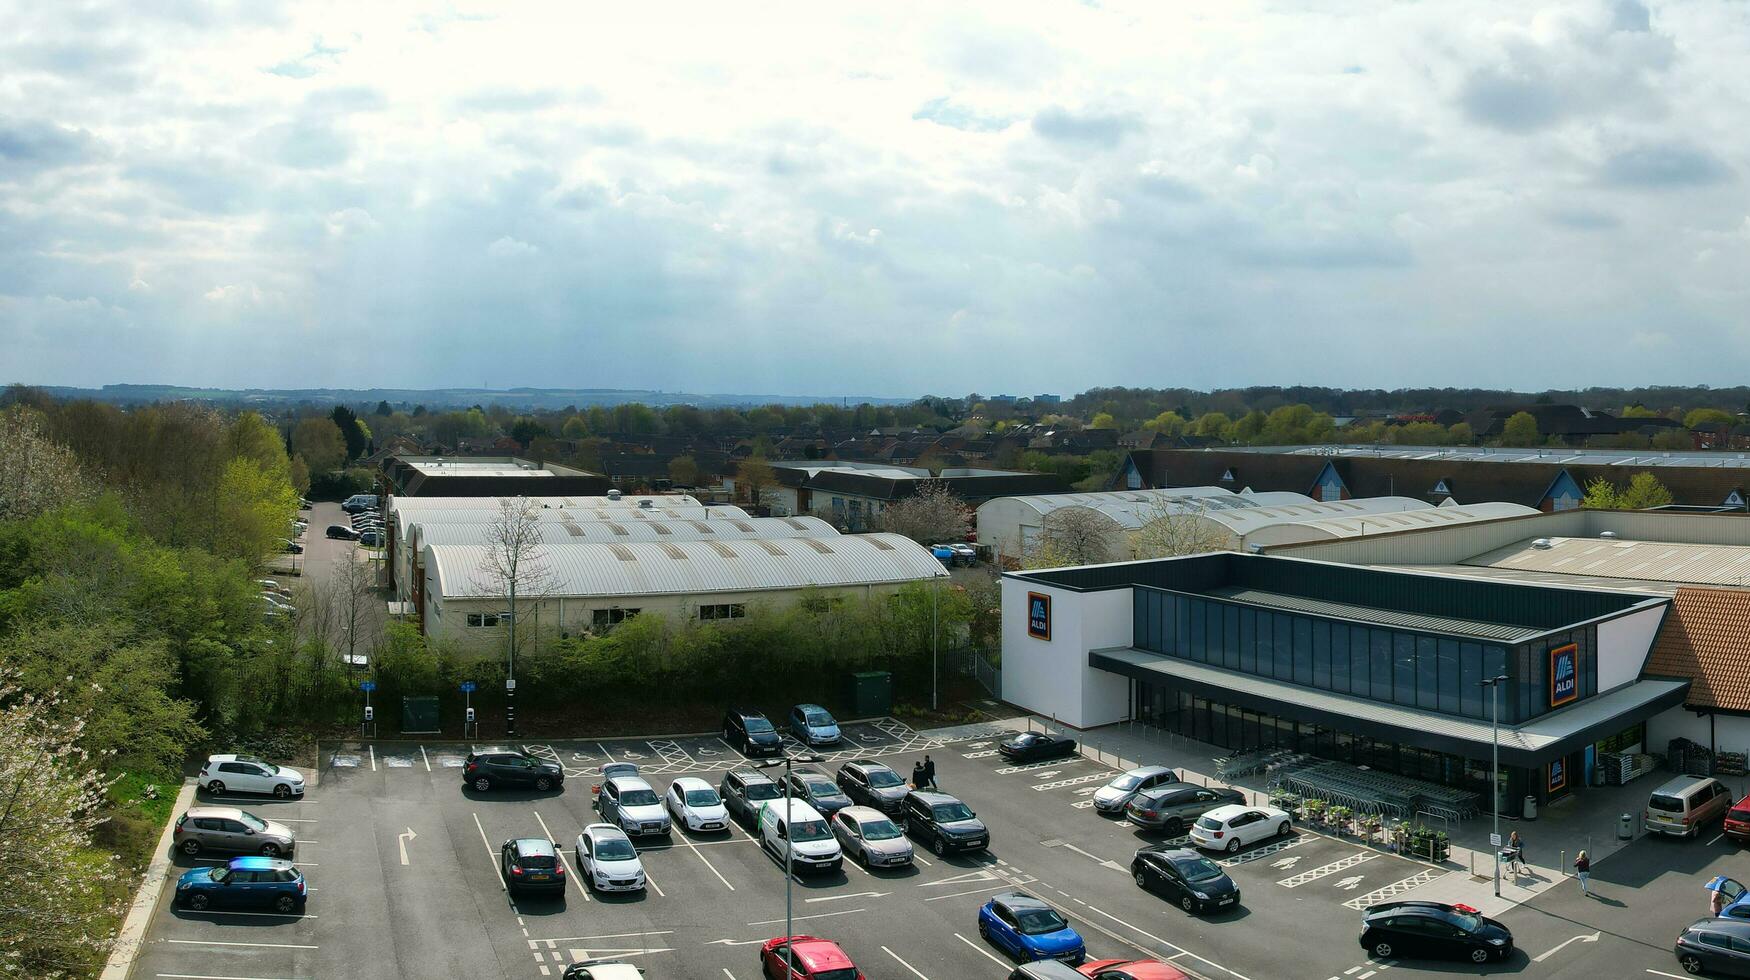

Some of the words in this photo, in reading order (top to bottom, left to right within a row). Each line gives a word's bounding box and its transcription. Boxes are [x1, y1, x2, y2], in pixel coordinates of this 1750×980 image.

[1031, 620, 1046, 631] ALDI
[1556, 679, 1574, 694] ALDI
[1552, 775, 1563, 785] ALDI
